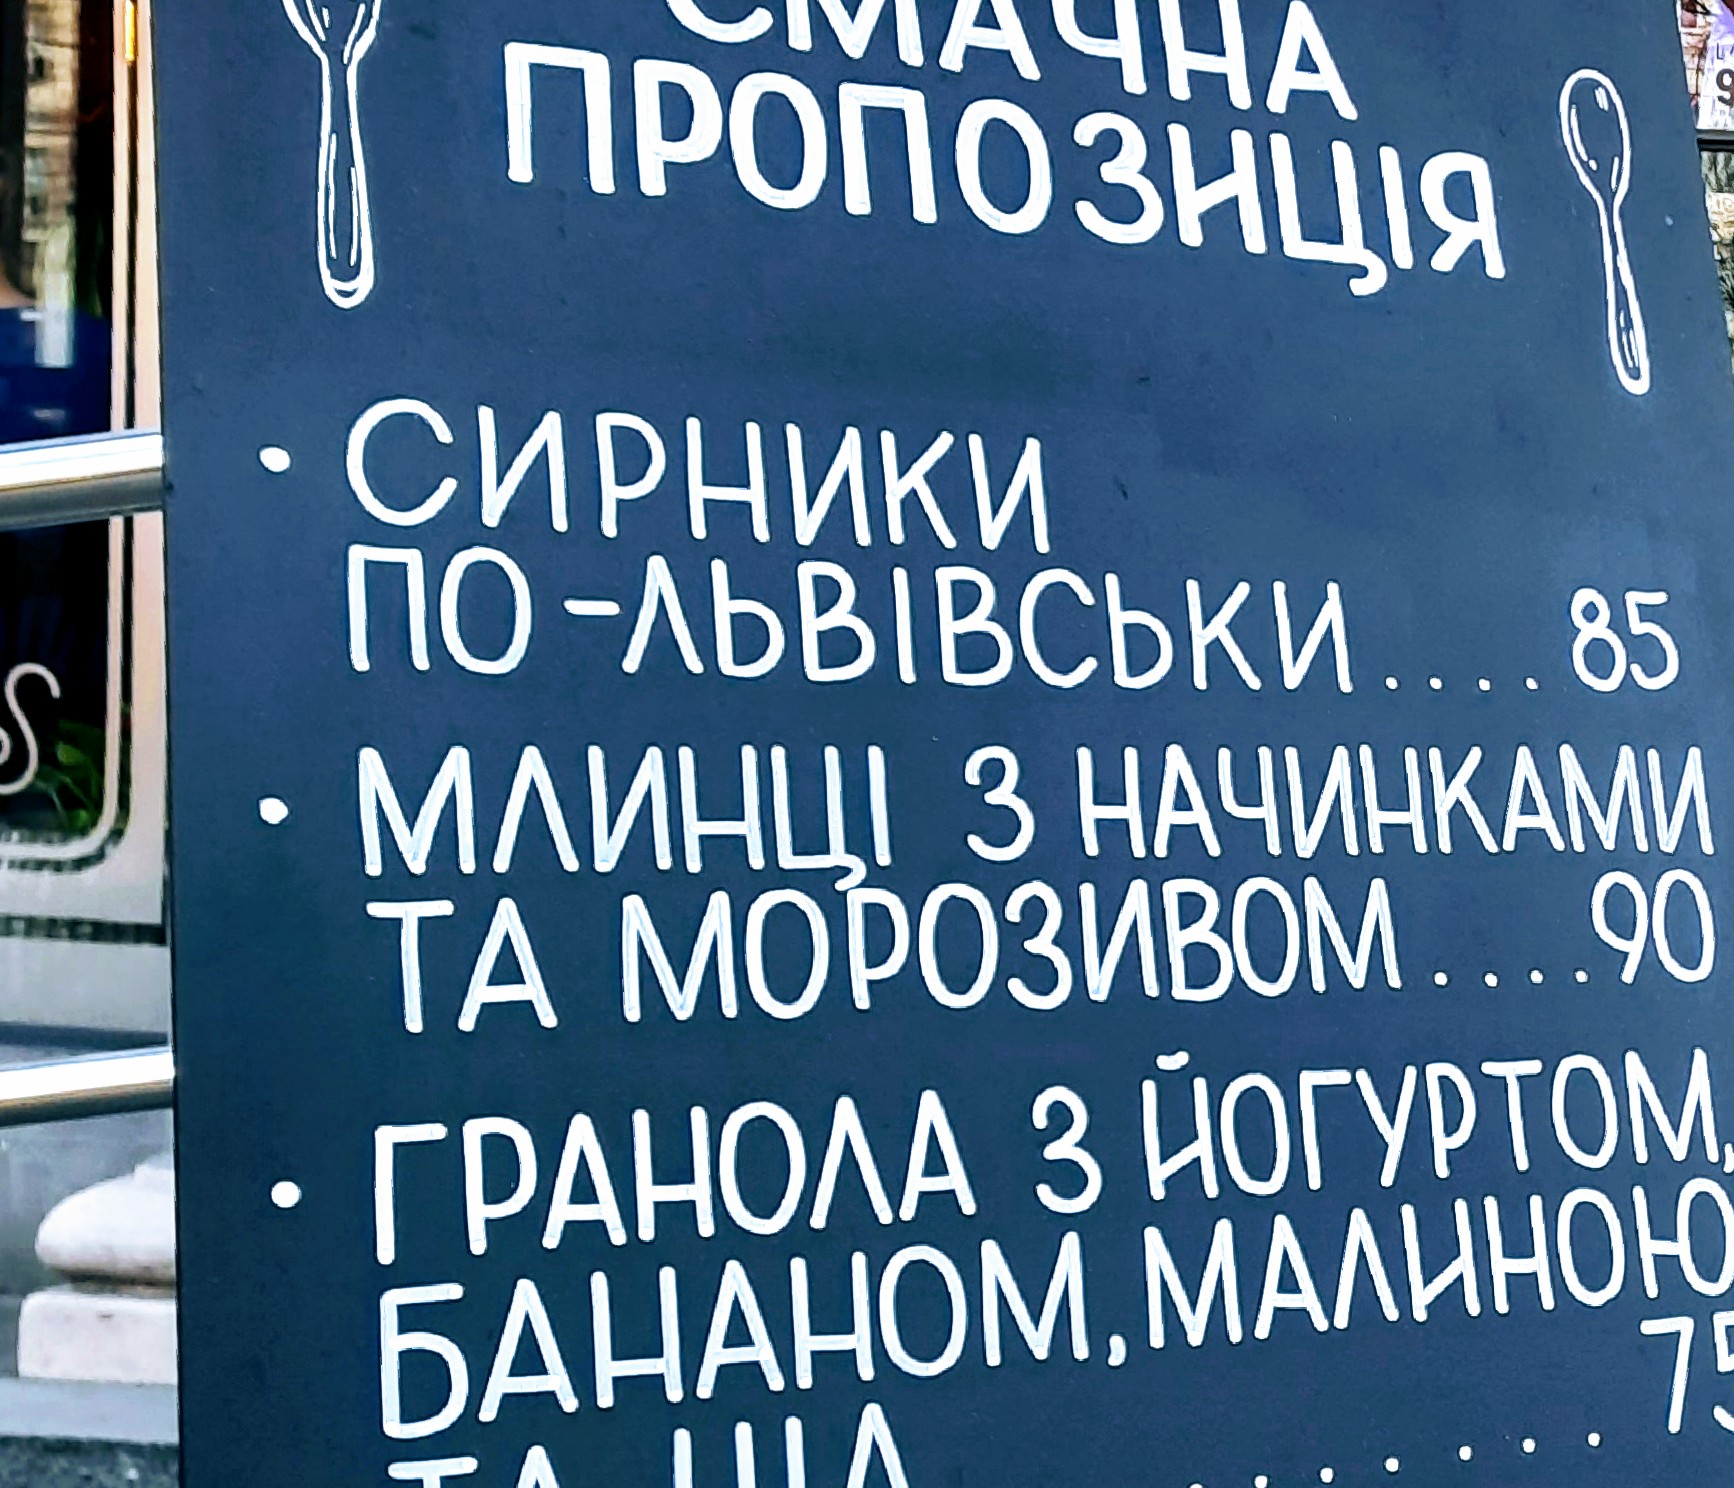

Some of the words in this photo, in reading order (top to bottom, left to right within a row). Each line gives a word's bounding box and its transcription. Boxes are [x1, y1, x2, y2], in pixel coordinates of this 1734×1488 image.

[502, 40, 1507, 297] ПРОПОЗИЦІЯ
[345, 397, 1052, 555] СИРНИКИ
[1569, 586, 1681, 693] 85
[357, 743, 893, 893] МЛИНЦІ
[1075, 742, 1716, 860] НАЧИНКАМИ
[365, 896, 559, 1035] ТА
[620, 875, 1404, 1024] МОРОЗИВОМ
[1589, 867, 1717, 986] 90
[373, 1088, 978, 1267] ГРАНОЛА
